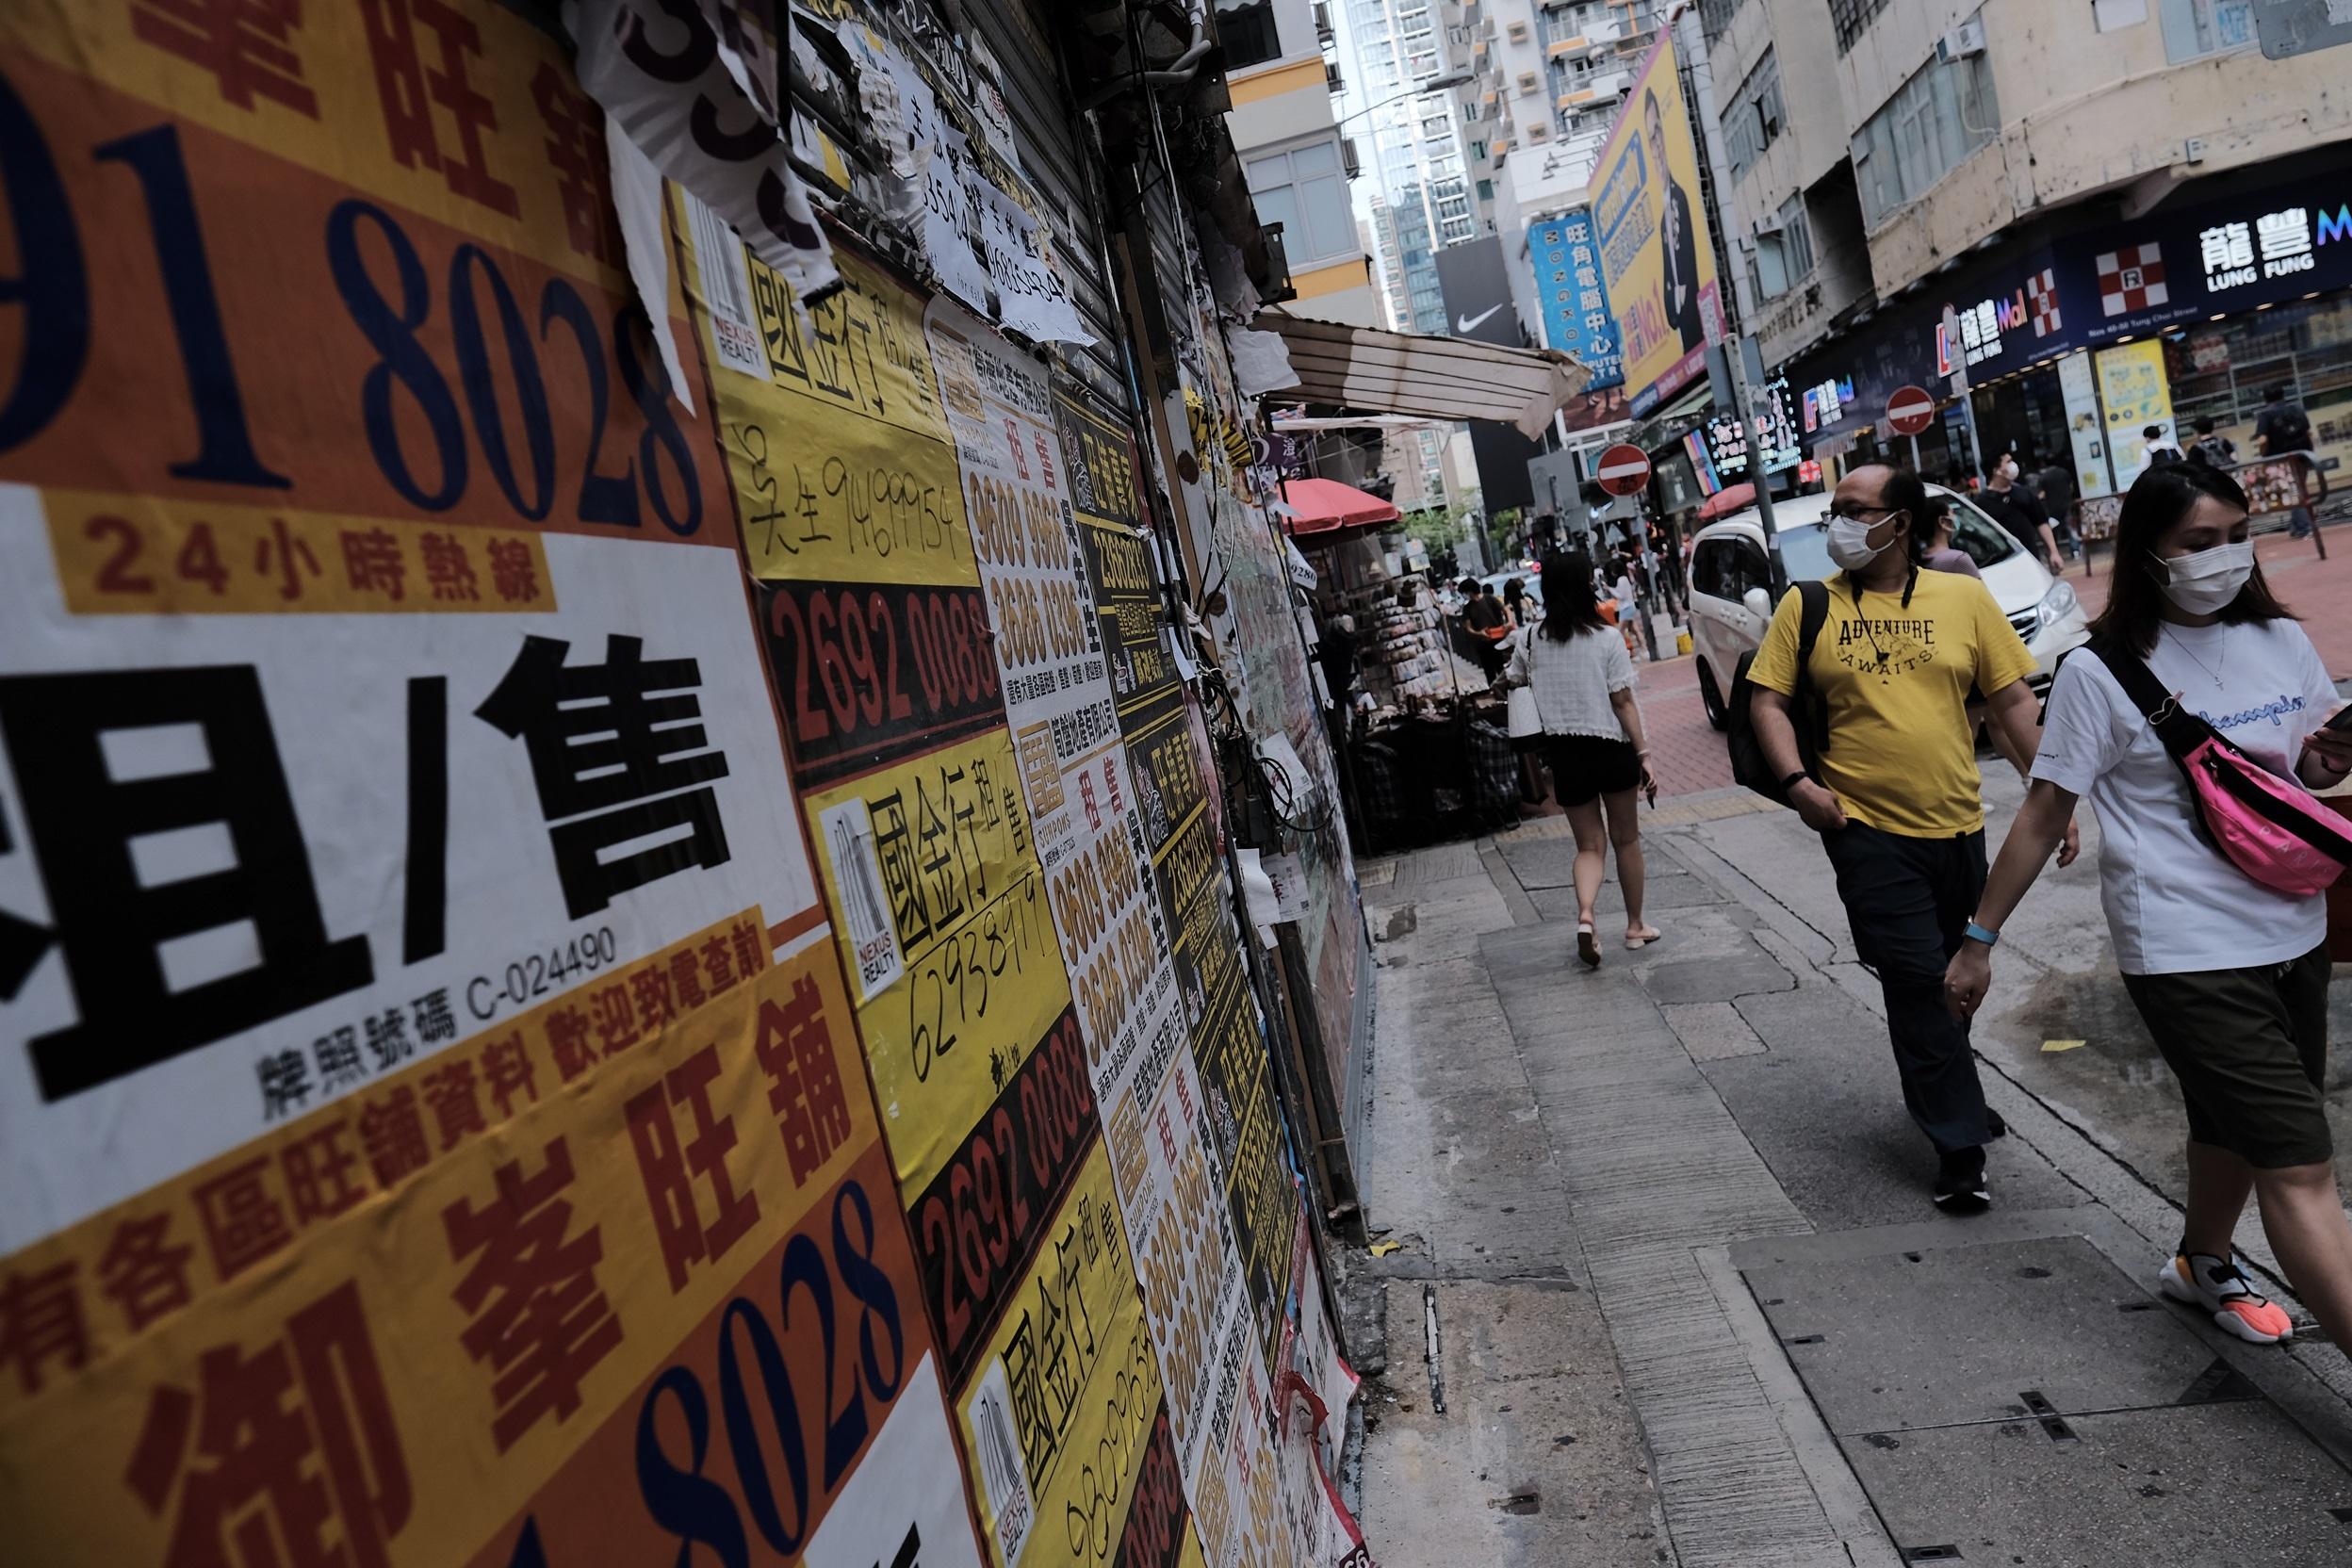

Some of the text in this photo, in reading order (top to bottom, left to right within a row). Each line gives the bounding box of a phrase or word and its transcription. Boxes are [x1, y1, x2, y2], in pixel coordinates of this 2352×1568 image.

[1565, 221, 1613, 355] 旺角電腦中心
[1996, 286, 2029, 334] Mall
[2206, 253, 2316, 293] LUNG FUNG
[325, 197, 704, 539] 8028
[714, 316, 757, 348] NEXUS
[718, 336, 761, 368] REALTY
[1002, 417, 1031, 482] 租
[1034, 431, 1057, 492] 售
[82, 514, 541, 602] 24小時熱線
[969, 470, 1069, 571] 9609 9966
[1091, 529, 1151, 590] 23662833
[770, 589, 999, 742] 2692 0088
[990, 576, 1047, 670] 3686
[1040, 579, 1086, 660] 0396
[1838, 619, 1936, 645] ADVENTURE
[1840, 649, 1933, 676] AWAITS
[1077, 767, 1102, 834] 租
[1102, 756, 1124, 817] 售
[1052, 849, 1106, 968] 9609
[1095, 819, 1139, 920] 9966
[1166, 817, 1213, 918] 23662833
[858, 930, 892, 965] NEXUS
[863, 951, 896, 987] REALTY
[255, 924, 617, 1123] 牌照號碼 C-024490
[545, 918, 768, 1085] 歡迎致電查詢
[1078, 940, 1126, 1068] 3686
[1156, 1067, 1195, 1170] 租 售
[921, 1014, 1092, 1355] 2692 0088
[1142, 1198, 1186, 1347] 9609
[634, 1178, 905, 1568] 8028
[1166, 1282, 1203, 1443] 3686
[1000, 1482, 1027, 1542] NEXUS
[1004, 1506, 1029, 1561] REALTY
